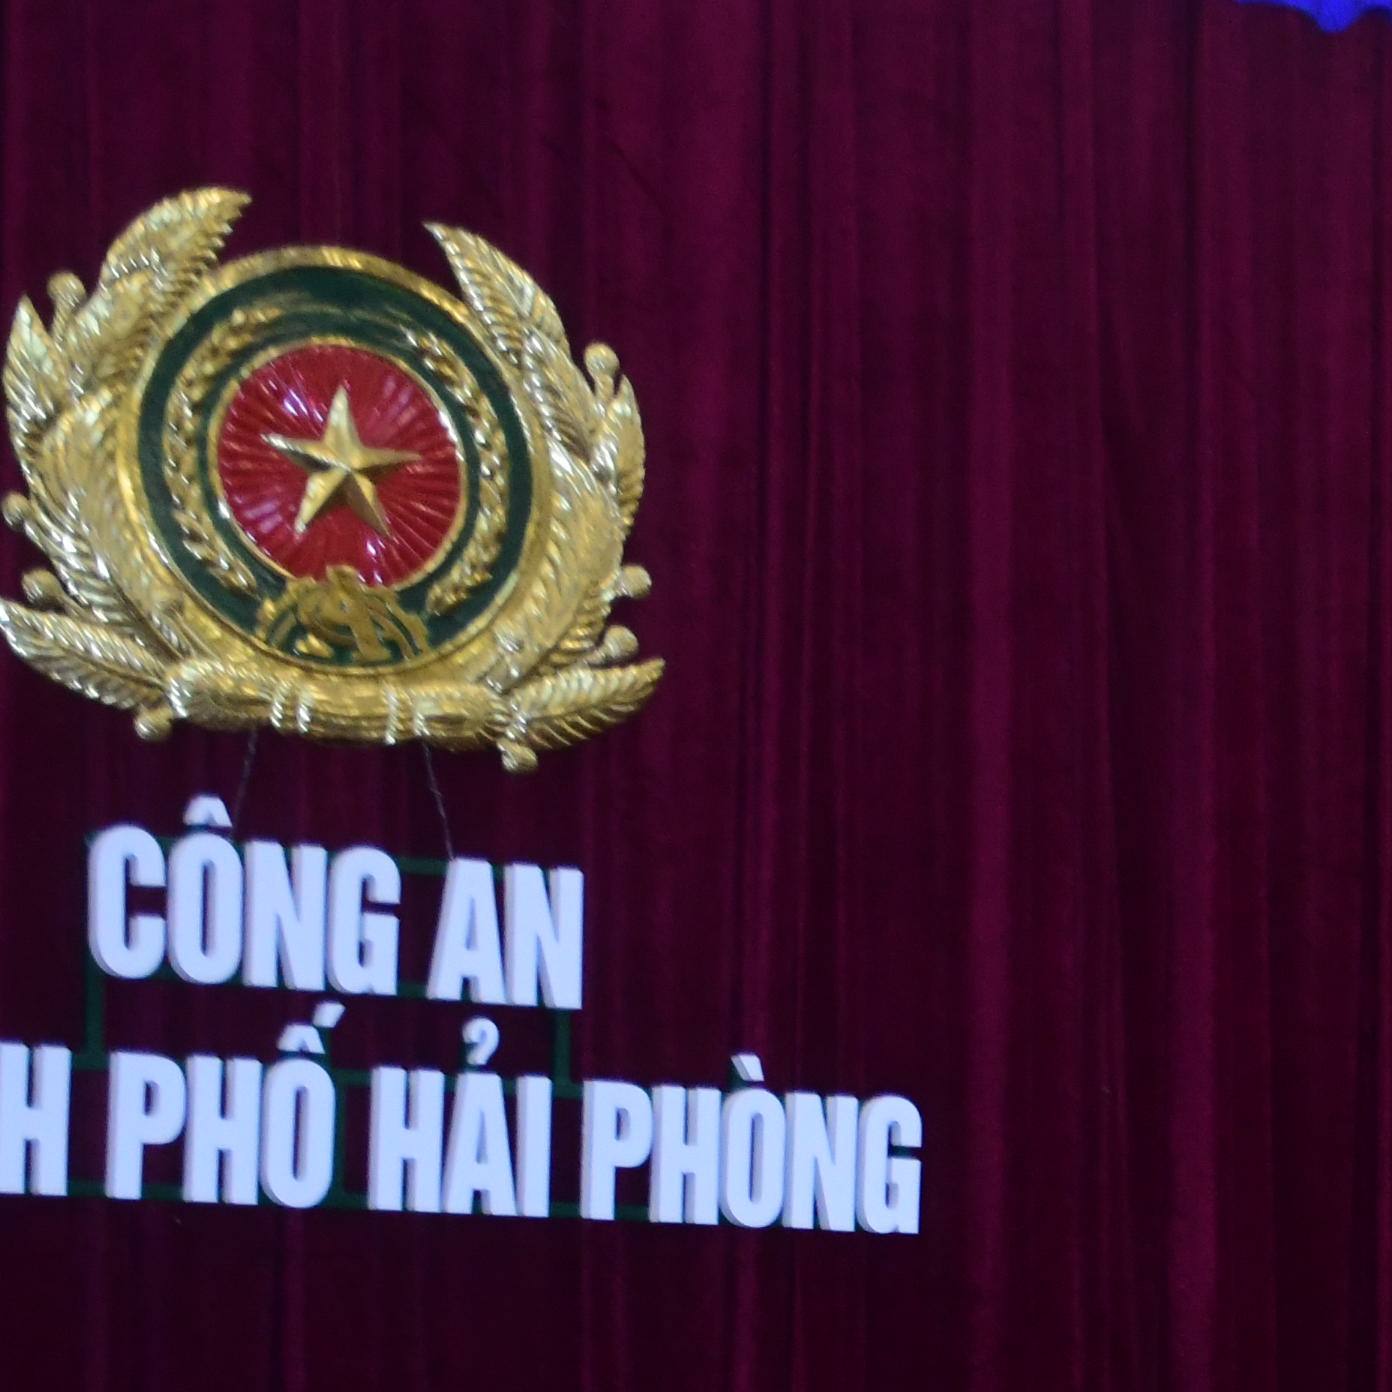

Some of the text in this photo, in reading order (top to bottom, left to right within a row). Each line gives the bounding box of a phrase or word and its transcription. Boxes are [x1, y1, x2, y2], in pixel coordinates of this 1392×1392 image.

[88, 795, 585, 1010] CÔNG AN
[105, 1002, 345, 1209] PHỐ
[368, 1017, 553, 1218] HẢI
[581, 1053, 923, 1235] PHÒNG
